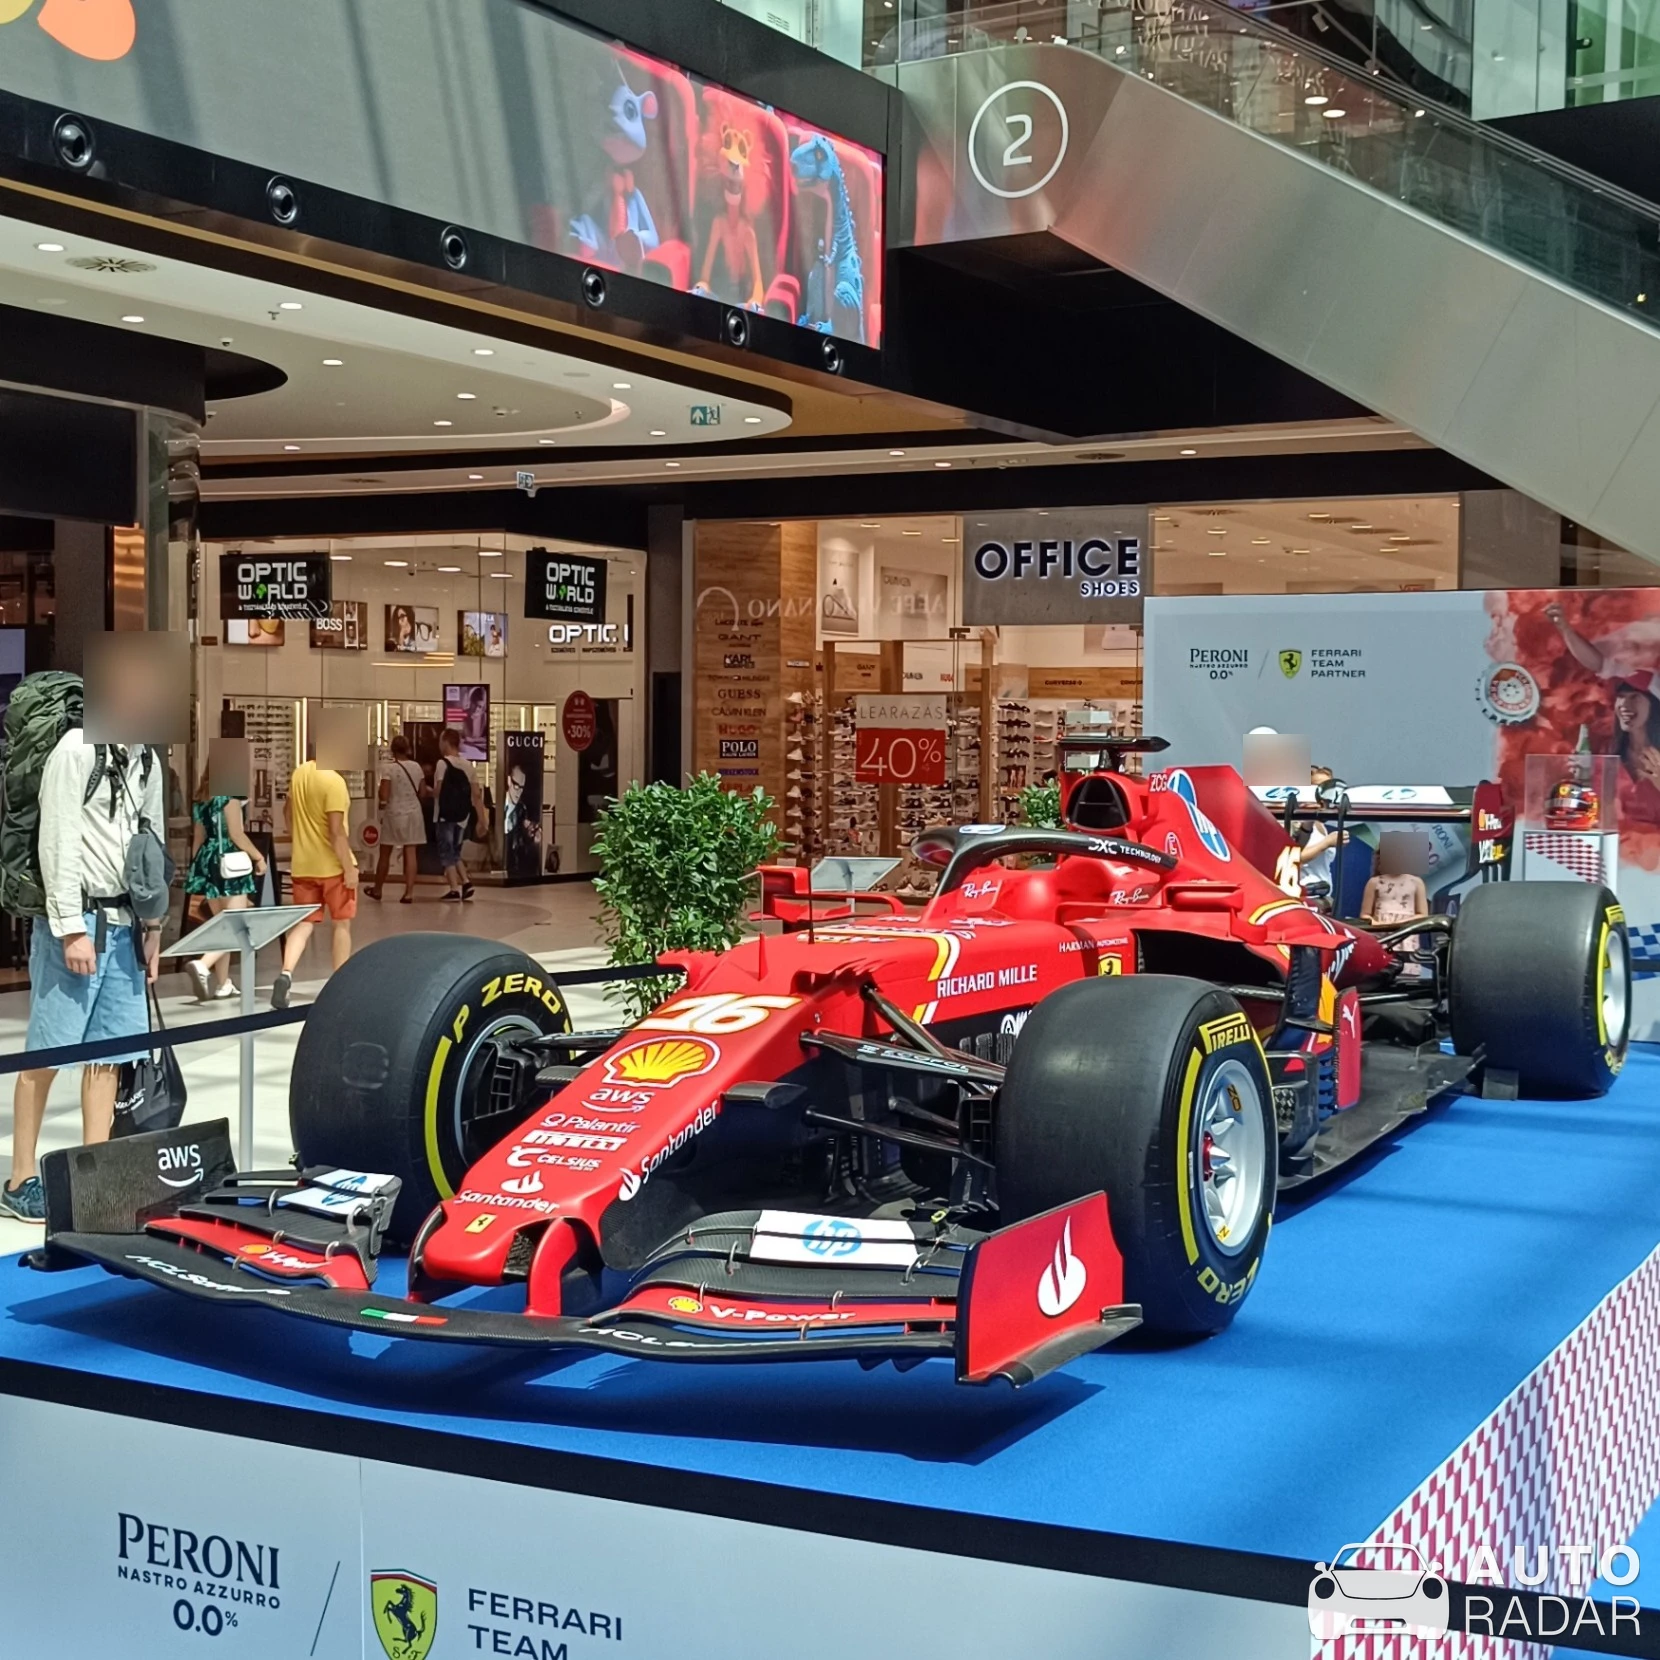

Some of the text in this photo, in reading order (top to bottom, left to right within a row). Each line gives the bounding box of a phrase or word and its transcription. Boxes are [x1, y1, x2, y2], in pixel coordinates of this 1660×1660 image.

[1003, 114, 1032, 166] 2
[974, 538, 1139, 579] OFFICE
[237, 562, 307, 583] OPTIC
[546, 561, 595, 587] OPTIC
[1080, 580, 1140, 596] SHOES
[316, 617, 343, 632] BOSS
[548, 623, 618, 643] OPTIC
[1189, 649, 1249, 663] PERONI
[1311, 670, 1366, 678] PARTNER
[718, 689, 761, 699] GUESS
[507, 735, 544, 748] GUCCI
[722, 741, 757, 753] POLO
[860, 737, 942, 779] 40%
[1150, 772, 1168, 792] ZCG
[1088, 837, 1162, 863] DXC TECHNOLOGY
[1058, 938, 1095, 953] HARMAN
[937, 964, 1038, 999] RICHARD MILLE
[453, 973, 562, 1043] P ZERO
[632, 992, 803, 1035] 16
[1199, 1012, 1251, 1055] PIRELLI
[589, 1087, 656, 1106] aws
[563, 1115, 642, 1133] Palantir
[521, 1130, 628, 1151] PIRELLI
[640, 1098, 719, 1185] Santander
[157, 1144, 202, 1171] aws
[536, 1152, 603, 1169] CELSIUS
[453, 1189, 561, 1214] Santander
[709, 1304, 857, 1322] V-Power
[117, 1511, 281, 1590] PERONI
[117, 1565, 281, 1610] NASTRO AZZURRO
[172, 1598, 239, 1637] 0.0%
[468, 1587, 623, 1641] FERRARI
[467, 1623, 568, 1660] TEAM
